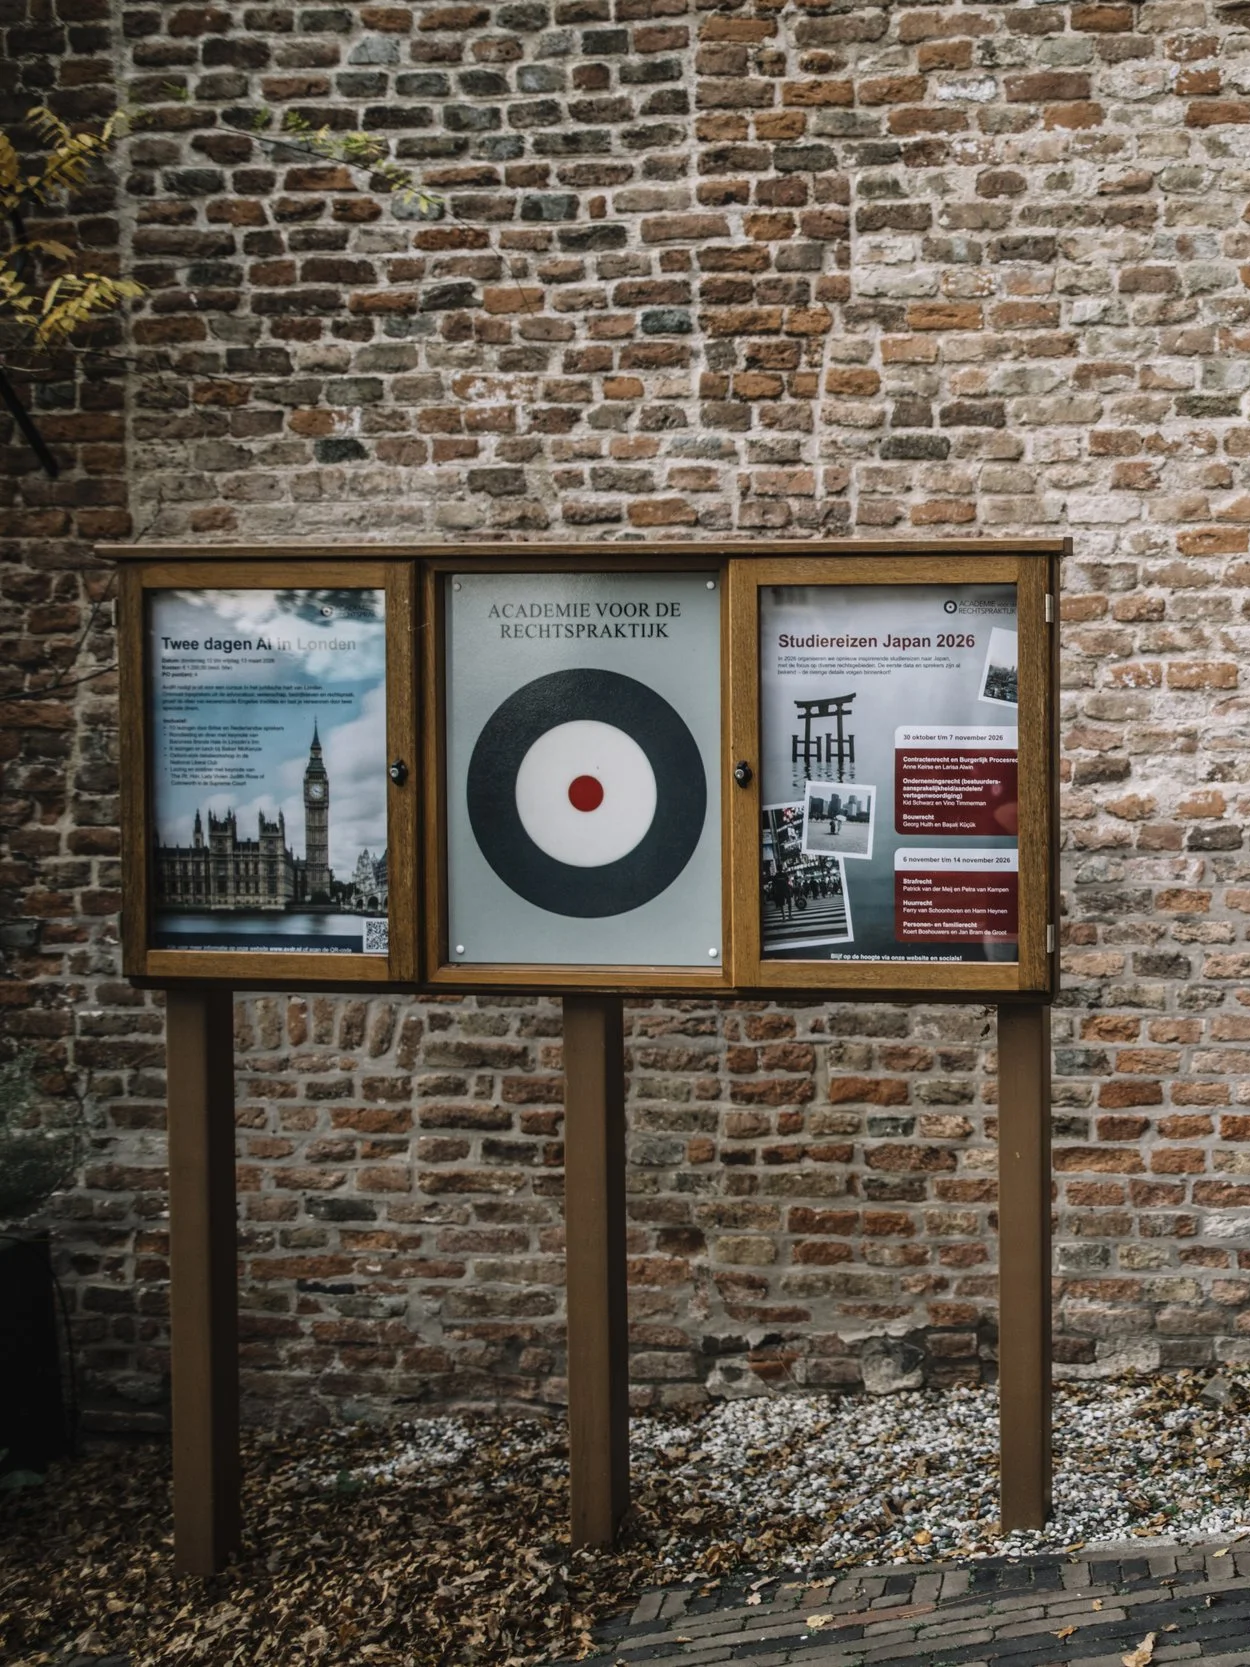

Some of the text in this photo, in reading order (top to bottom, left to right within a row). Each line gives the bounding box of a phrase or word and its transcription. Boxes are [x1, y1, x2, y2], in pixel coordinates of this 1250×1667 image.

[488, 602, 682, 619] ACADEMIE VOOR DE
[500, 623, 669, 639] RECHTSPRAKTIJK
[161, 638, 198, 650] Twee
[204, 638, 252, 653] dagen
[277, 638, 292, 650] in
[297, 638, 356, 650] Londen
[778, 634, 976, 651] Studiereizen Japan 2026
